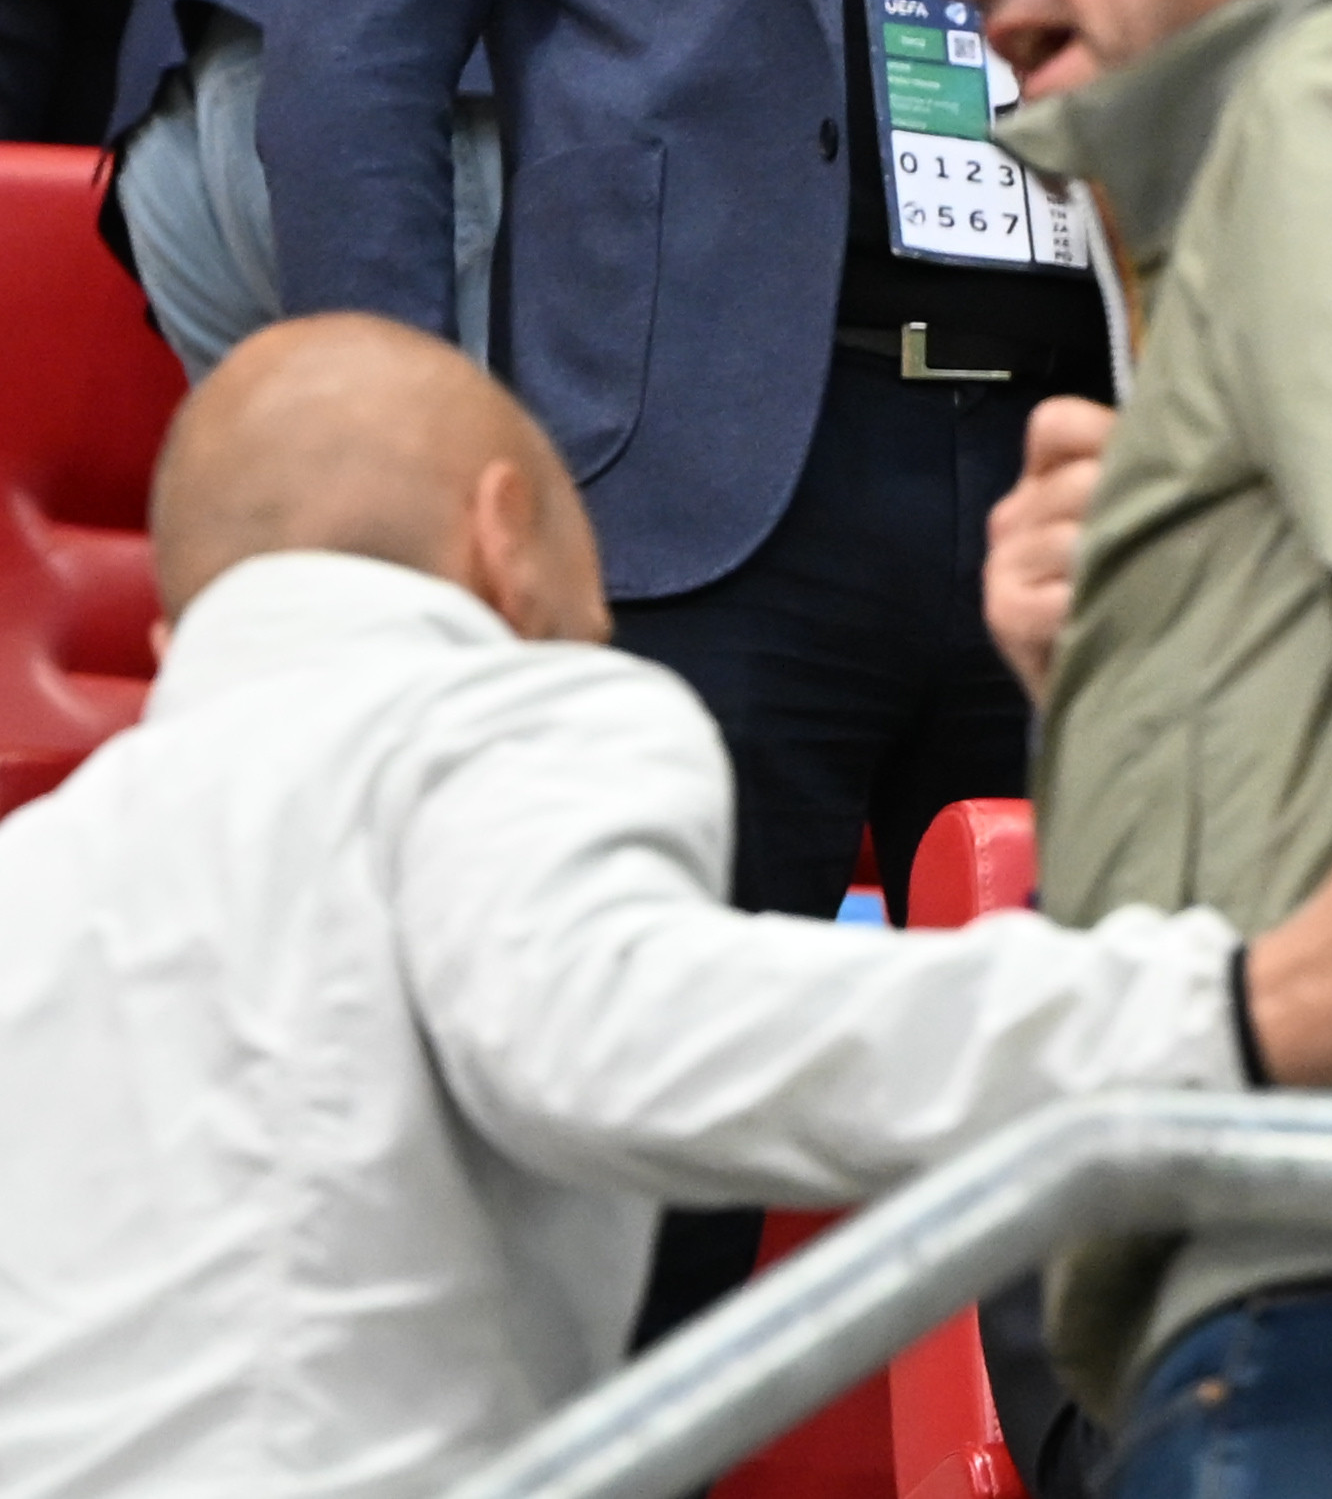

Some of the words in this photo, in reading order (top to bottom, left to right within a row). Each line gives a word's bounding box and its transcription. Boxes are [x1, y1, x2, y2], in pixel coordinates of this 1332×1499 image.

[900, 152, 919, 174] 0
[934, 157, 950, 180] 1
[966, 161, 984, 183] 2
[999, 165, 1015, 188] 3
[938, 205, 956, 228] 5
[969, 209, 988, 233] 6
[1001, 214, 1020, 236] 7
